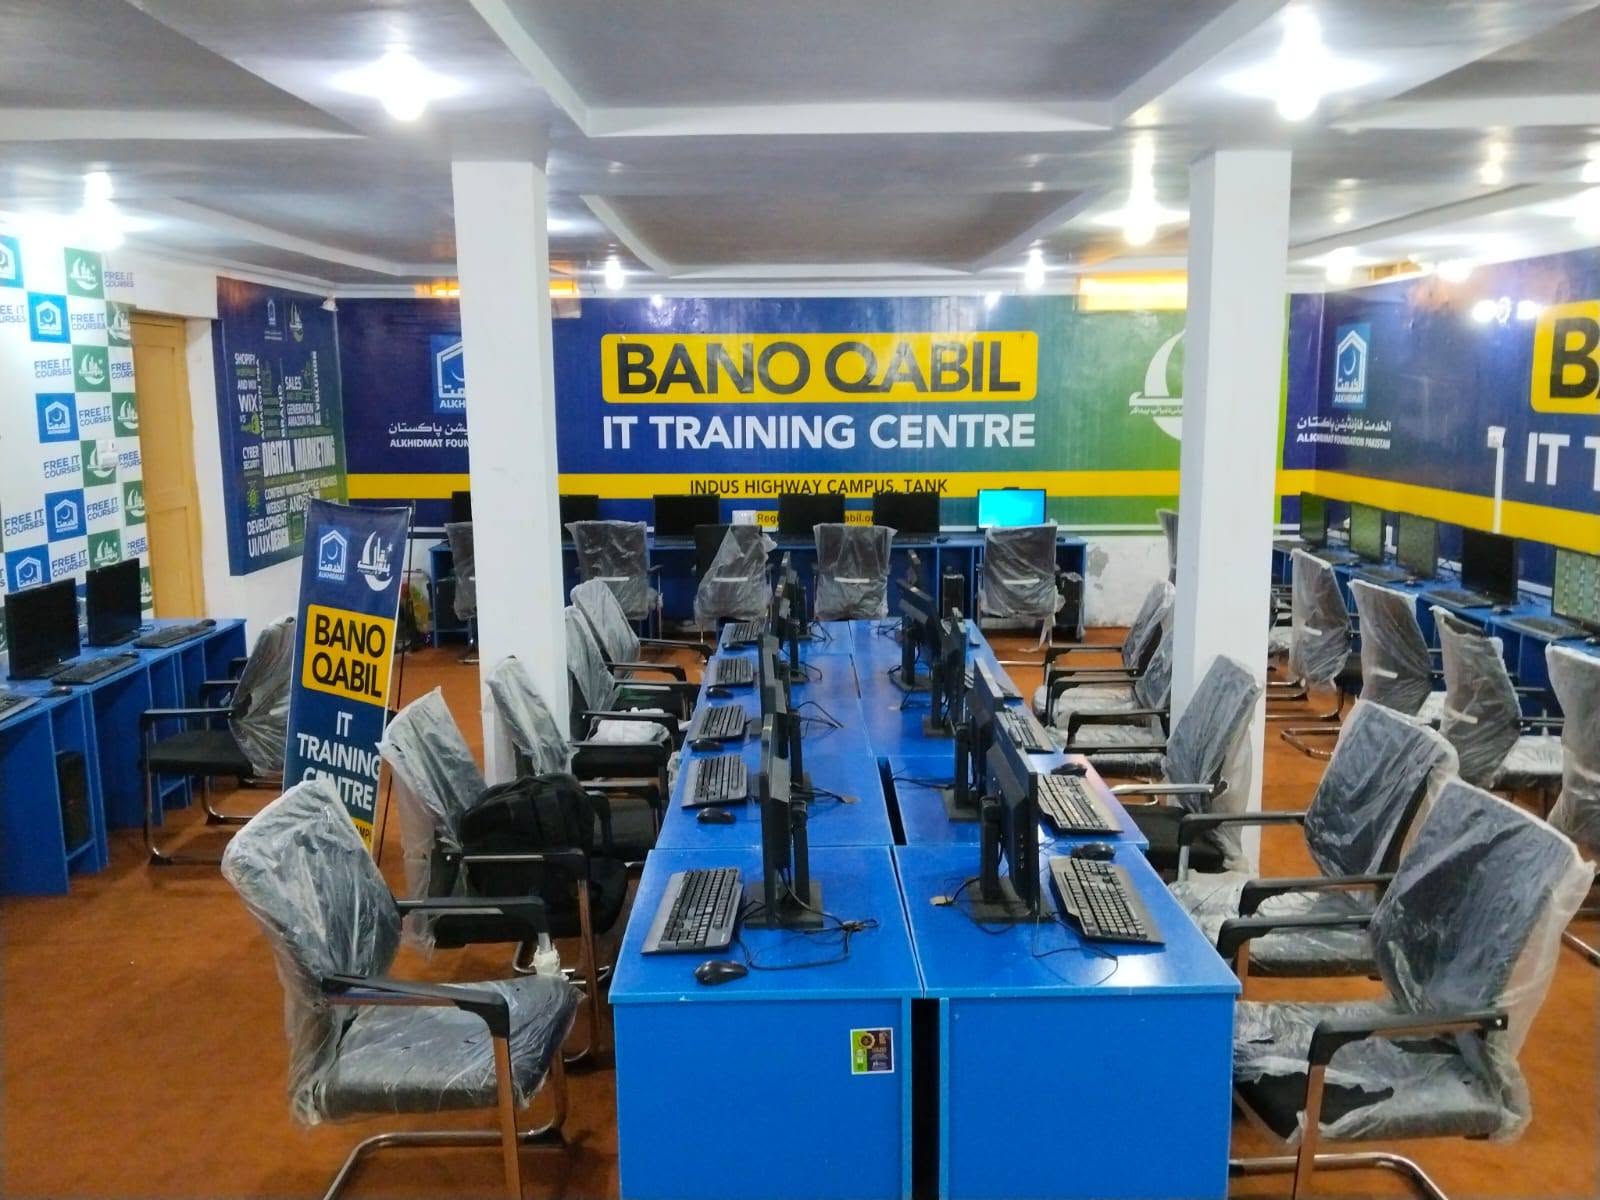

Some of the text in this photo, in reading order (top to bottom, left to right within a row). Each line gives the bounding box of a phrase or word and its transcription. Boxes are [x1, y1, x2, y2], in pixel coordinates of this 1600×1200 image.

[71, 312, 104, 322] FREE IT
[34, 358, 72, 370] FREE IT
[35, 367, 72, 378] COURSES
[111, 362, 132, 371] FREE
[617, 340, 1021, 395] BANO QABIL
[238, 393, 259, 412] WIX
[79, 406, 111, 418] FREE IT
[80, 415, 112, 426] COURSES
[603, 413, 1036, 449] IT TRAINING CENTRE
[43, 455, 80, 470] FREE IT
[119, 450, 139, 461] FREE
[262, 435, 336, 477] DIGITAL MARKETING
[1525, 432, 1570, 486] IT
[44, 465, 80, 478] COURSES
[690, 480, 740, 493] INDUS
[745, 479, 822, 493] HIGHWAY
[904, 478, 948, 493] TANK
[87, 497, 118, 513] FREE IT
[4, 509, 44, 529] FREE IT
[246, 512, 288, 535] DEVELOPMENT
[5, 520, 45, 537] COURSES
[52, 550, 87, 569] FREE IT
[52, 561, 88, 577] COURSES
[314, 613, 386, 658] BANO
[312, 652, 382, 698] QABIL
[336, 710, 353, 737] IT
[296, 732, 380, 781] TRAINING
